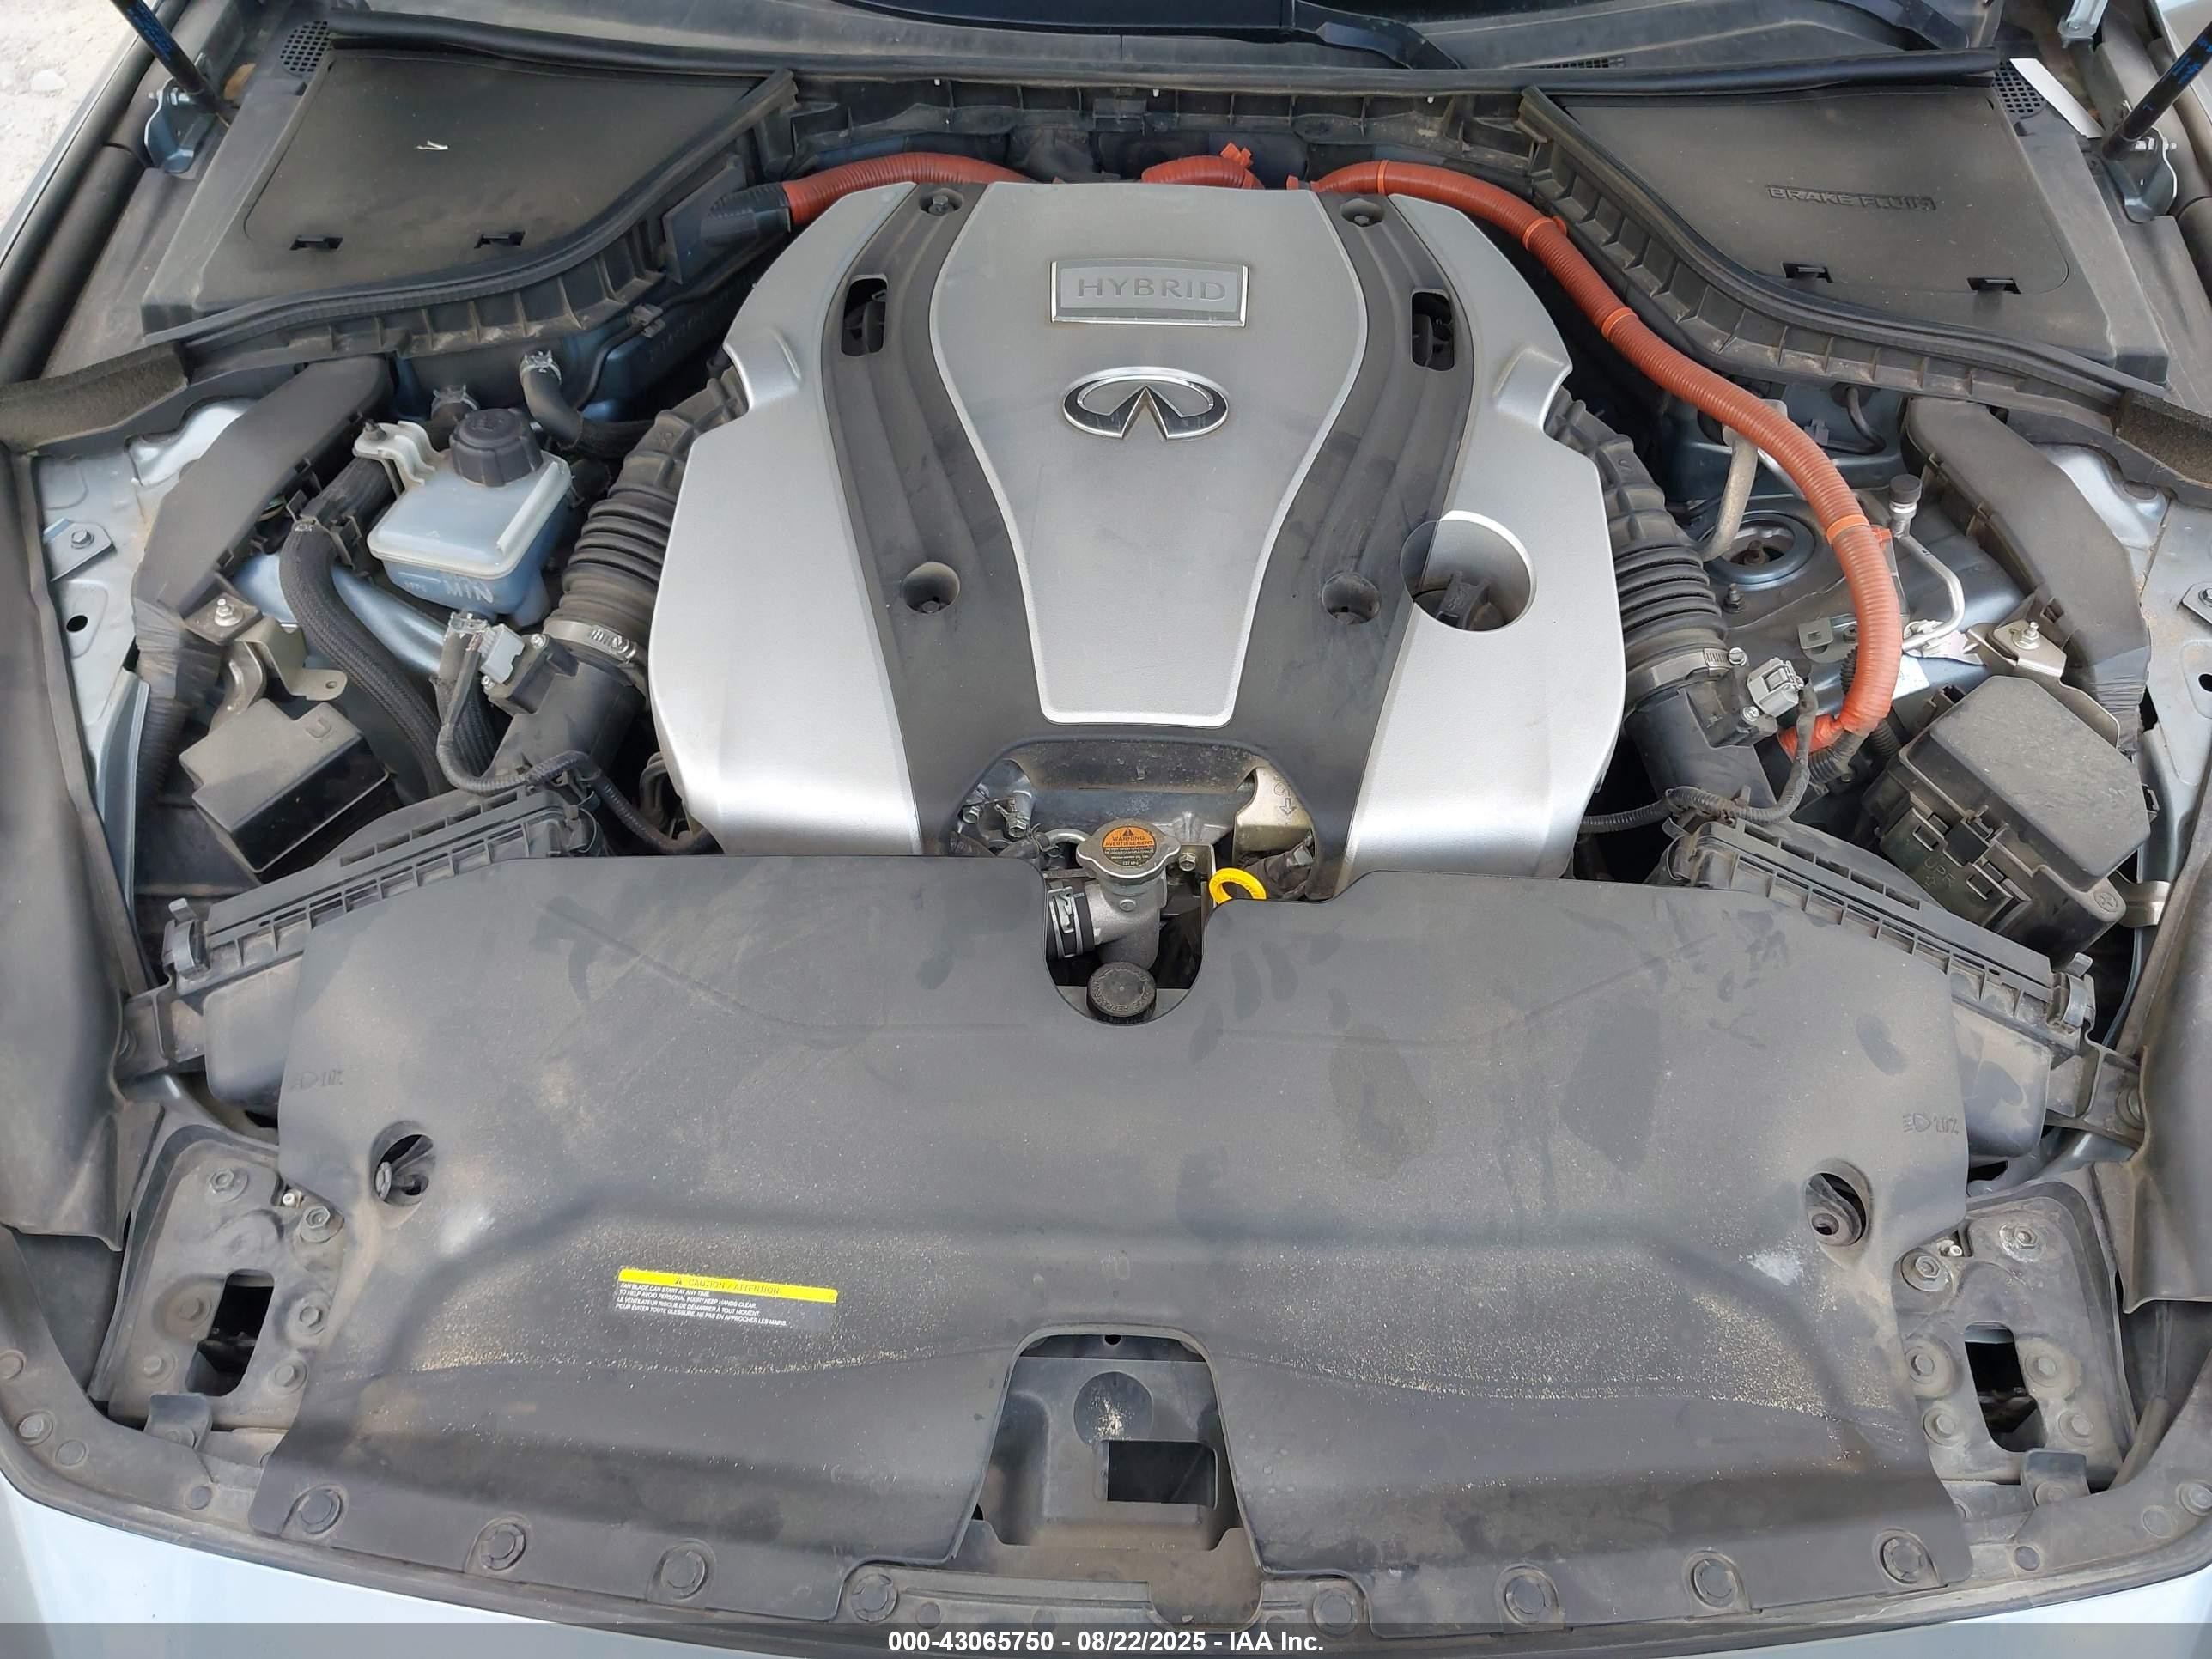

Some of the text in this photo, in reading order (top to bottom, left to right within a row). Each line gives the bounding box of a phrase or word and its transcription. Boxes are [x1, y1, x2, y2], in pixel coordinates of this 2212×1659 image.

[1768, 186, 1936, 211] BRAKE FLUID
[1078, 278, 1226, 301] HYBRID
[444, 578, 494, 603] MIN
[658, 1292, 685, 1302] PERSONAL
[688, 1279, 725, 1288] CAUTION
[733, 1282, 780, 1295] ATTENTION
